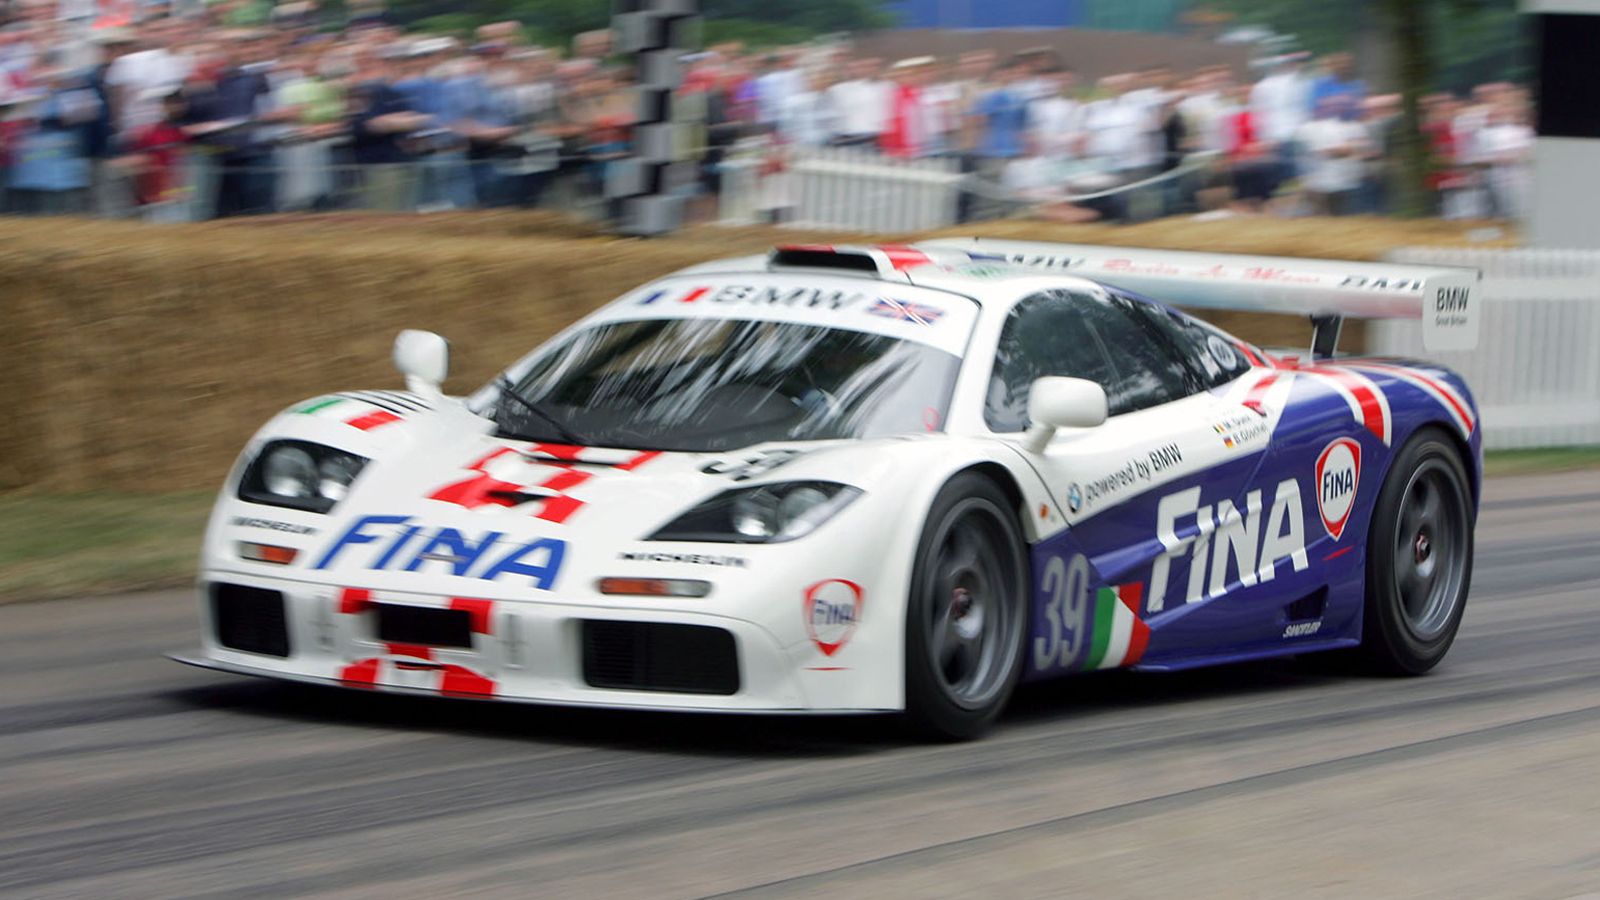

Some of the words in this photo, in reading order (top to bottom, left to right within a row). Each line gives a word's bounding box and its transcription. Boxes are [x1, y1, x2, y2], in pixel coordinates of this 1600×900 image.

[712, 285, 863, 310] BMW
[1436, 287, 1470, 312] BMW
[1085, 460, 1136, 506] powered
[1133, 457, 1152, 482] by
[1148, 442, 1183, 472] BMW
[229, 515, 321, 536] MICHELIN
[618, 551, 749, 569] MICHELIN
[1033, 552, 1089, 671] 39
